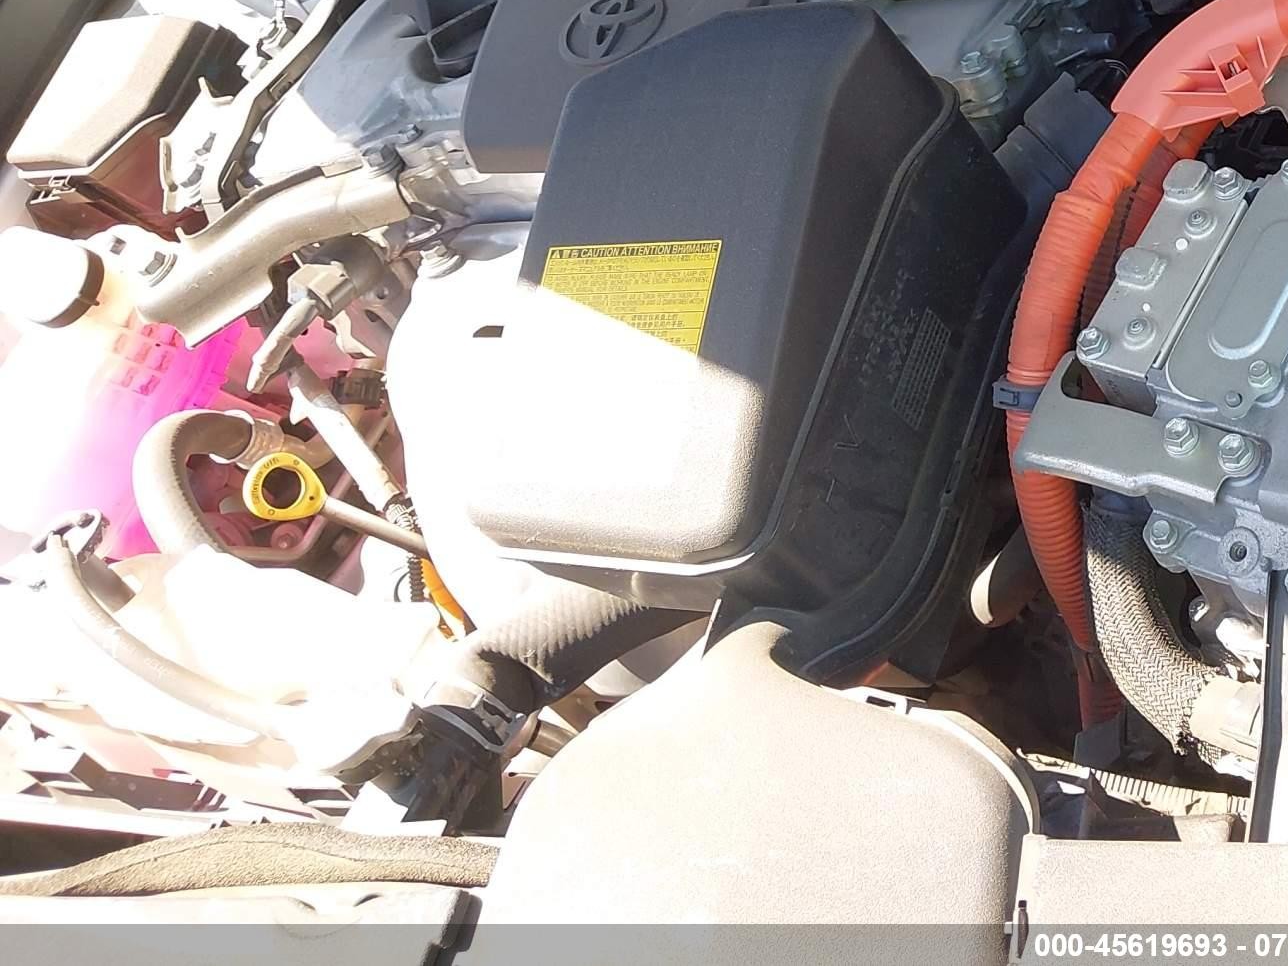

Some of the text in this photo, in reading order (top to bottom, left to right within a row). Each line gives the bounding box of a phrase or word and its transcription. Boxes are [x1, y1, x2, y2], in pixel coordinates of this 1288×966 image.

[581, 247, 619, 257] CAUTION
[621, 245, 672, 256] ATTENTION
[671, 243, 718, 254] ВНИМАНИЕ
